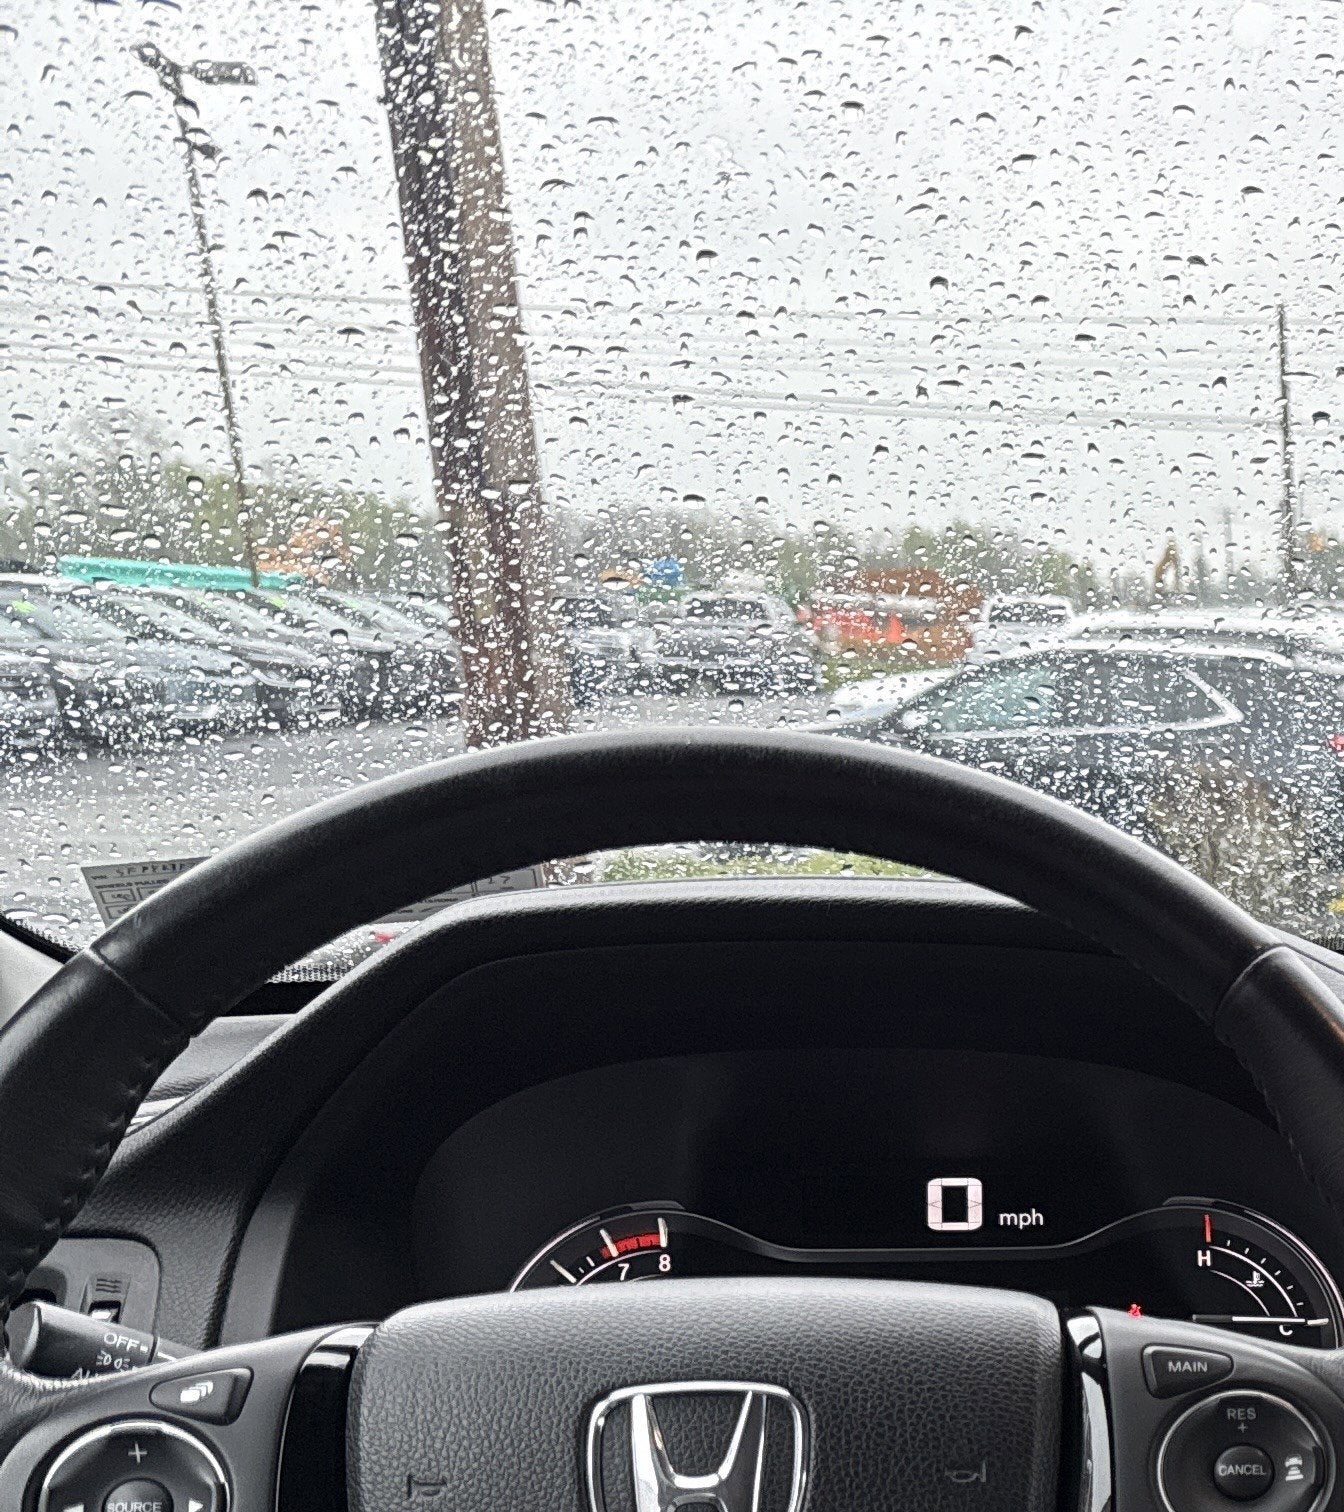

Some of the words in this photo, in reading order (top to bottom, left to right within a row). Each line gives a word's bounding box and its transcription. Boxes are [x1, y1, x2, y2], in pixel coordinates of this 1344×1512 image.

[927, 1177, 983, 1231] 0
[999, 1208, 1044, 1230] mph
[658, 1253, 671, 1272] 8
[1197, 1249, 1211, 1267] H
[617, 1263, 630, 1281] 7
[103, 1331, 141, 1351] OFF
[1167, 1360, 1208, 1373] MAIN
[1226, 1407, 1257, 1420] RES
[1218, 1464, 1266, 1477] CANCEL
